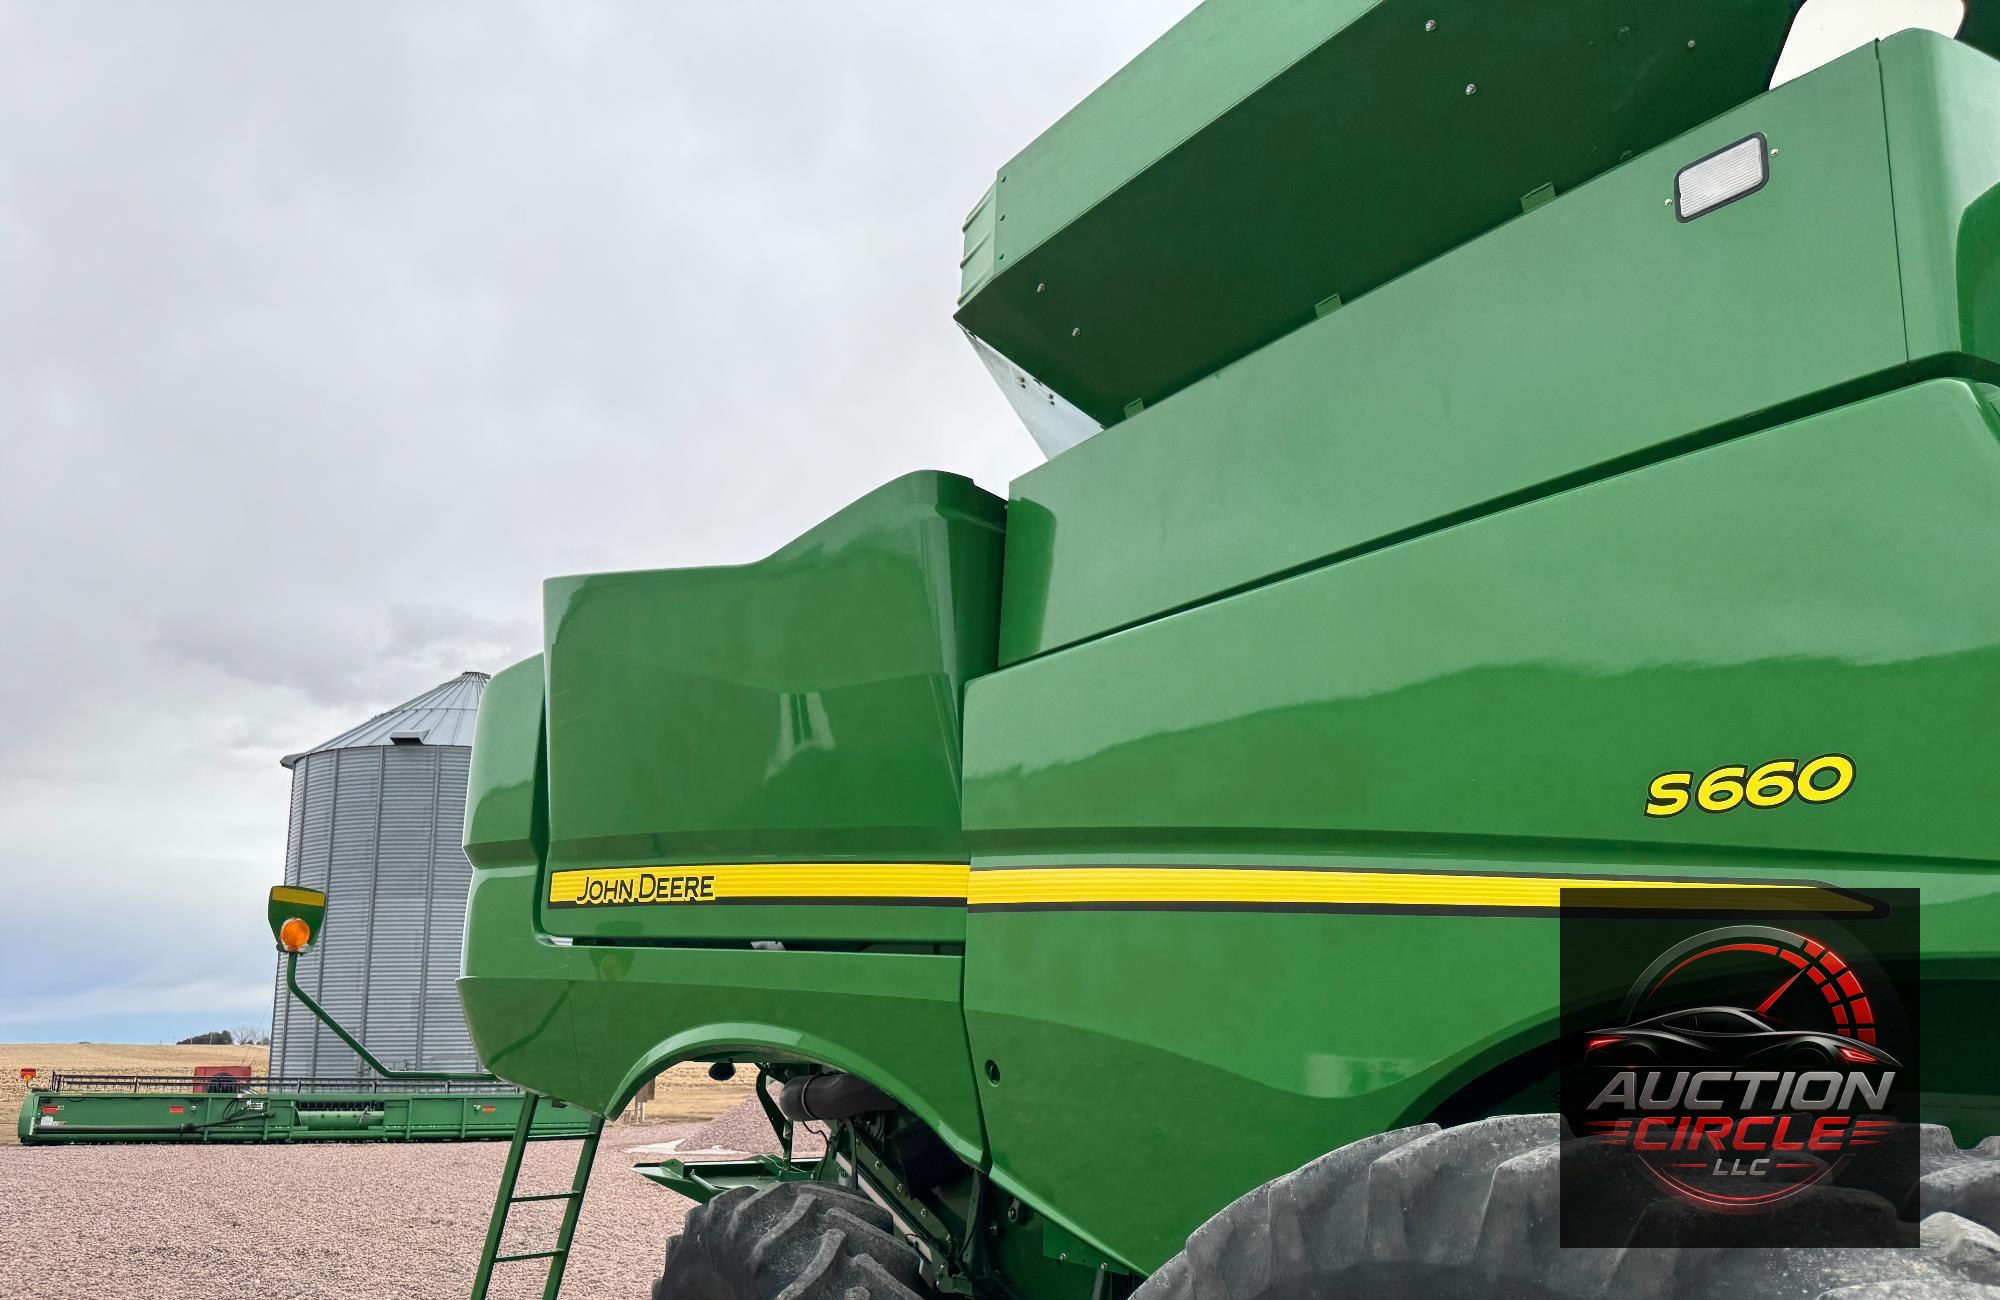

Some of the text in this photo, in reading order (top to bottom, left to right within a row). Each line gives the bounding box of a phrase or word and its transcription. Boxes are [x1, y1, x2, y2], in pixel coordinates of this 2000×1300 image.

[1644, 753, 1856, 818] S660
[576, 873, 715, 901] JOHN DEERE
